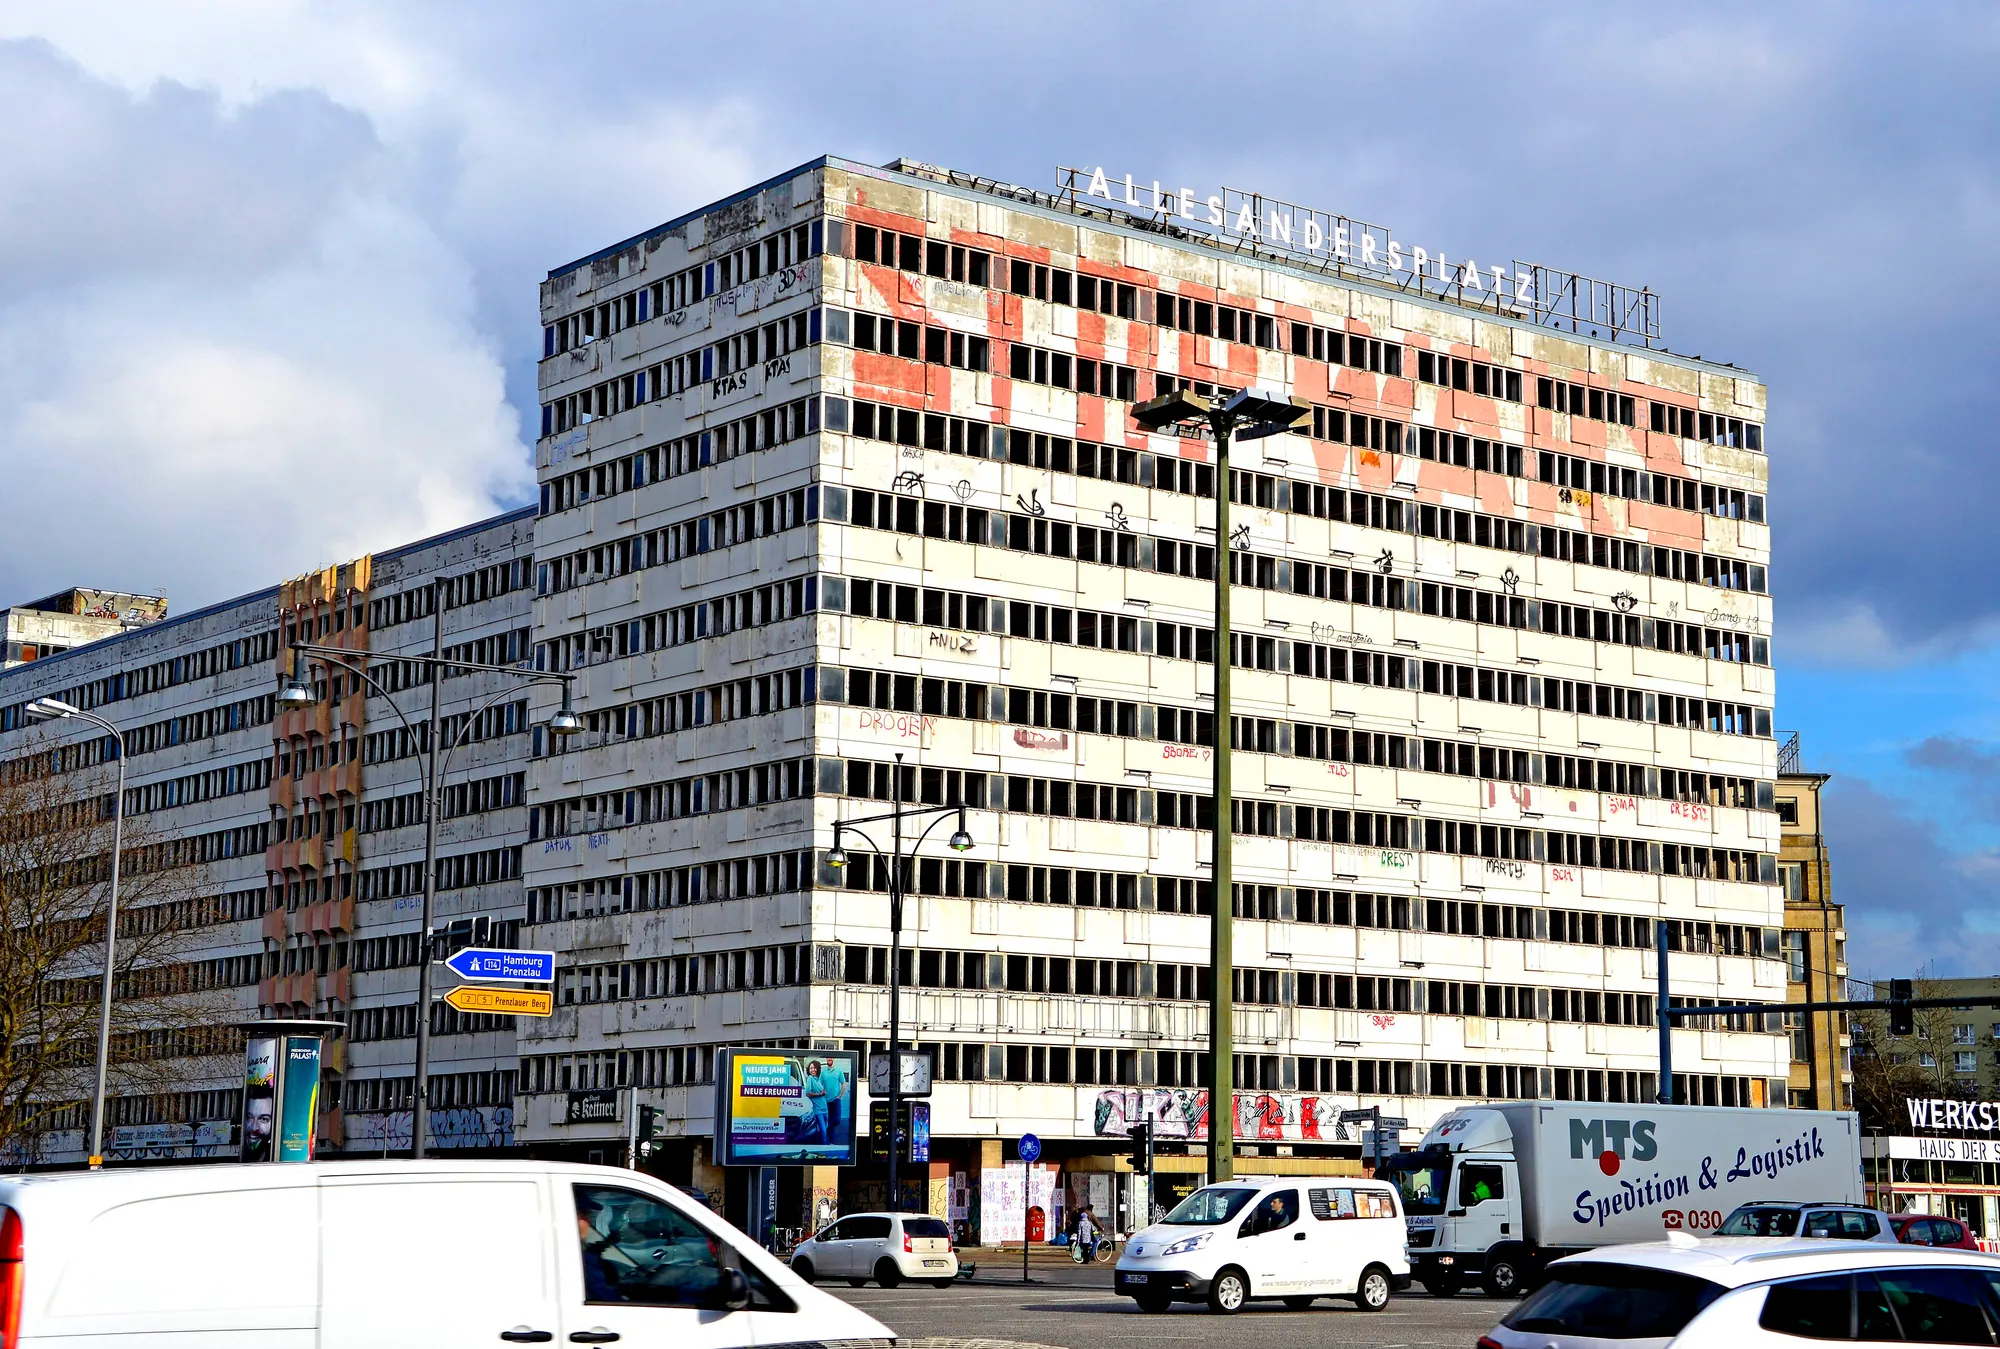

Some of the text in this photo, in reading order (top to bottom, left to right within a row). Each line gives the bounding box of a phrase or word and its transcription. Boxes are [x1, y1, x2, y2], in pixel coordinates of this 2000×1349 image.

[1087, 166, 1534, 300] ALLESANDERSPLATZ
[929, 631, 977, 653] ANUZ
[1311, 621, 1334, 643] RIP
[1381, 850, 1413, 868] CREST
[503, 955, 543, 968] Hamburg
[503, 966, 541, 977] Prenzlau
[495, 997, 528, 1007] Prenzlauer
[531, 999, 546, 1010] Berg
[746, 1076, 784, 1085] NEUER JOB
[769, 1066, 787, 1075] JAHR
[744, 1087, 798, 1096] NEUE FREUNDE!
[582, 1097, 614, 1119] Kettner
[1569, 1118, 1658, 1162] MTS
[1919, 1139, 1955, 1158] HAUS
[1962, 1141, 1987, 1160] DER
[1573, 1126, 1825, 1227] Spedition & Logistik
[1688, 1209, 1722, 1230] 030
